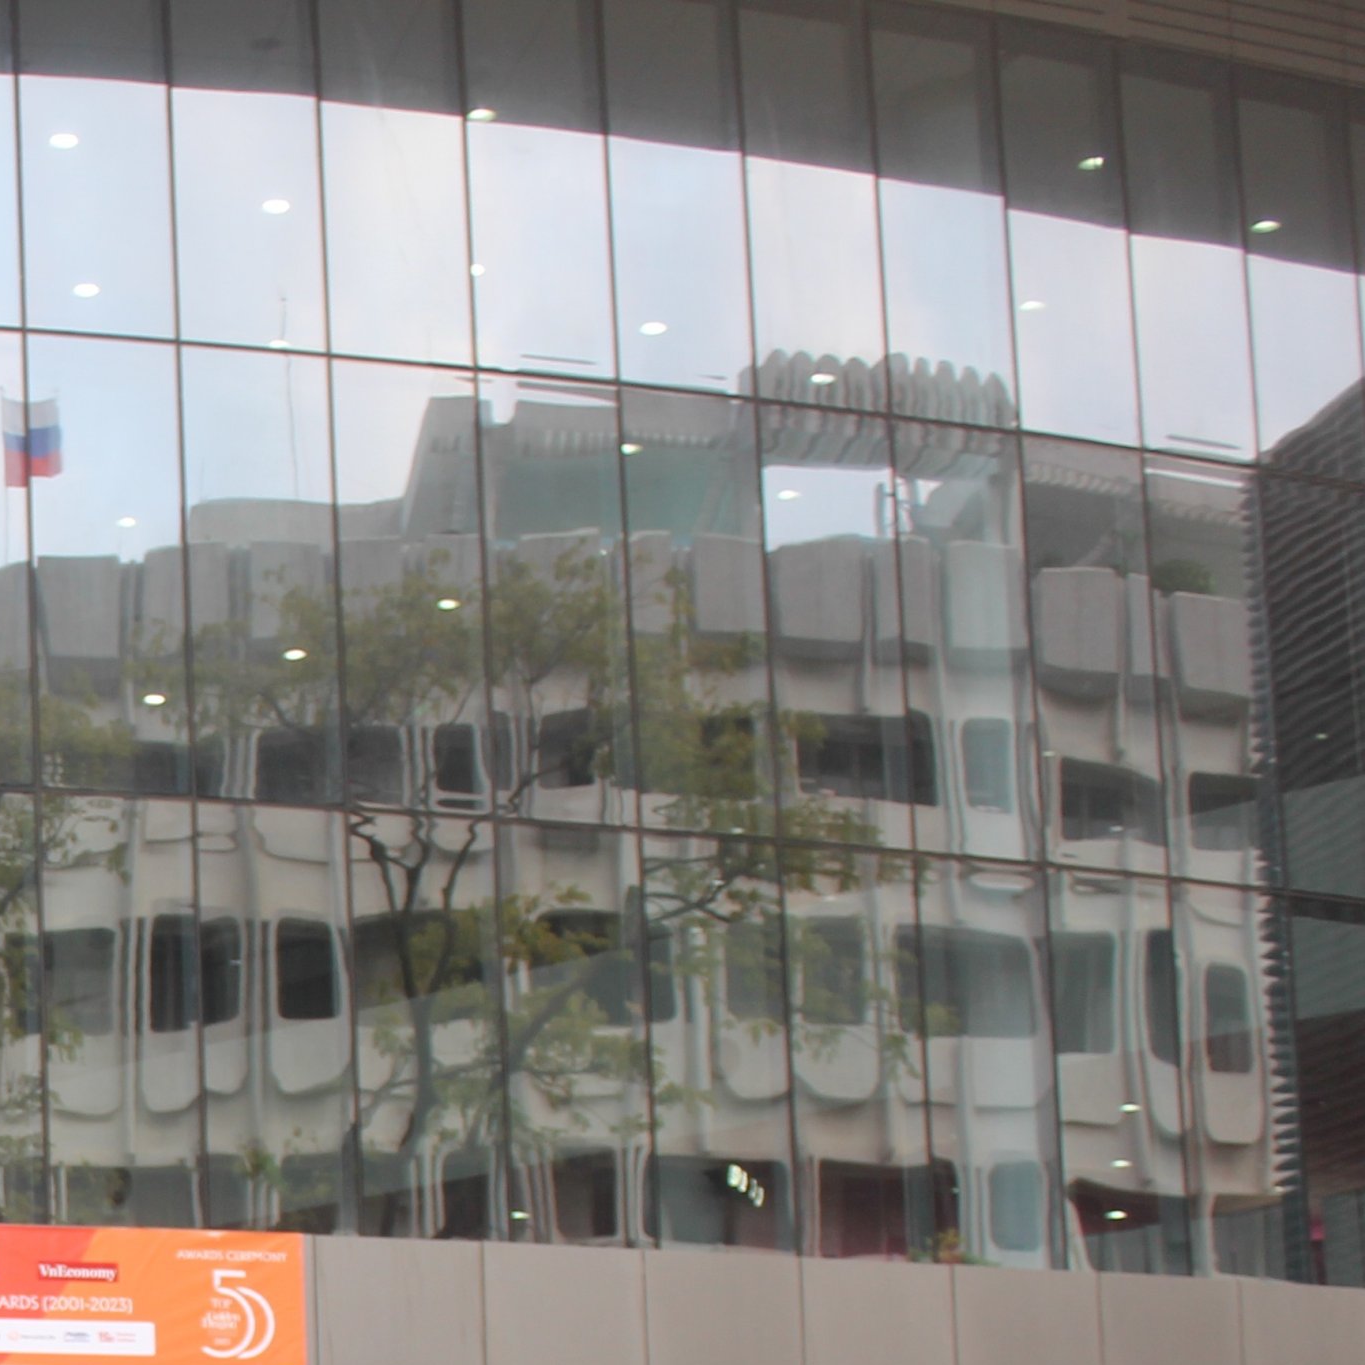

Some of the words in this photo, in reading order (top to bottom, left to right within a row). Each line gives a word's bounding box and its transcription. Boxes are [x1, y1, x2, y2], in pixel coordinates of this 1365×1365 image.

[176, 1249, 224, 1261] AWARDS
[225, 1250, 288, 1263] CEREMONY
[38, 1263, 118, 1281] VnEconomy
[42, 1295, 134, 1314] (2001-2023)
